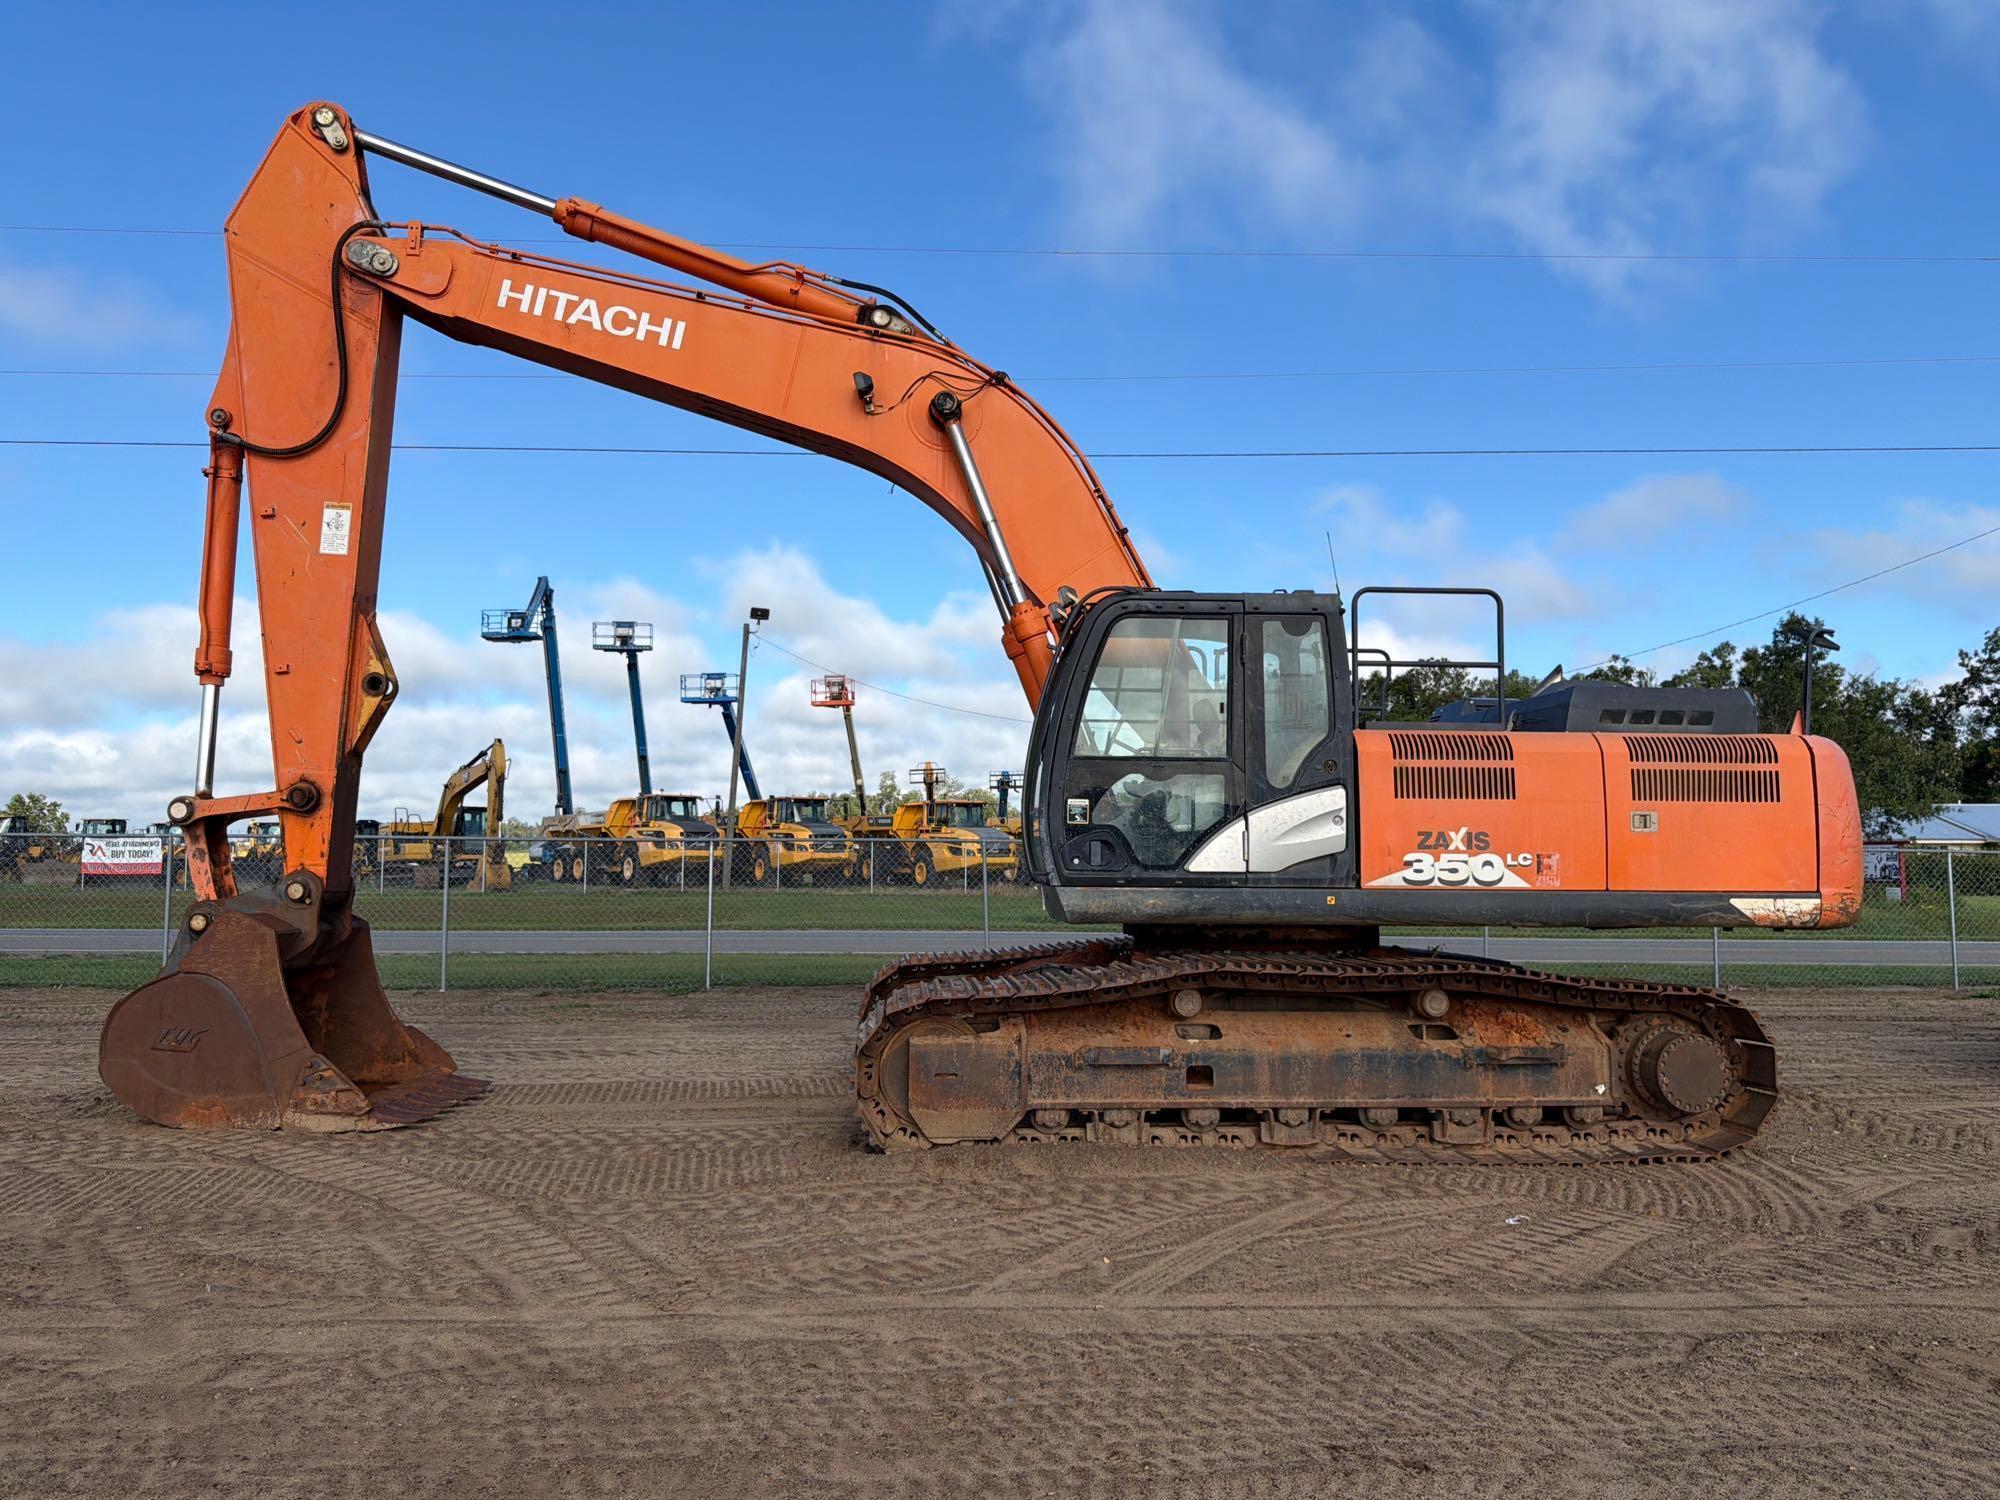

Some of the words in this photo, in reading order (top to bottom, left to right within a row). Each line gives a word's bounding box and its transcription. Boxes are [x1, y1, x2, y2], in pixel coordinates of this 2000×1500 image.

[496, 278, 687, 350] HITACHI
[1416, 826, 1490, 851] ZAXIS
[111, 850, 126, 859] BUY
[128, 850, 153, 859] TODAY!
[1402, 852, 1505, 887] 350
[1506, 852, 1533, 868] LC
